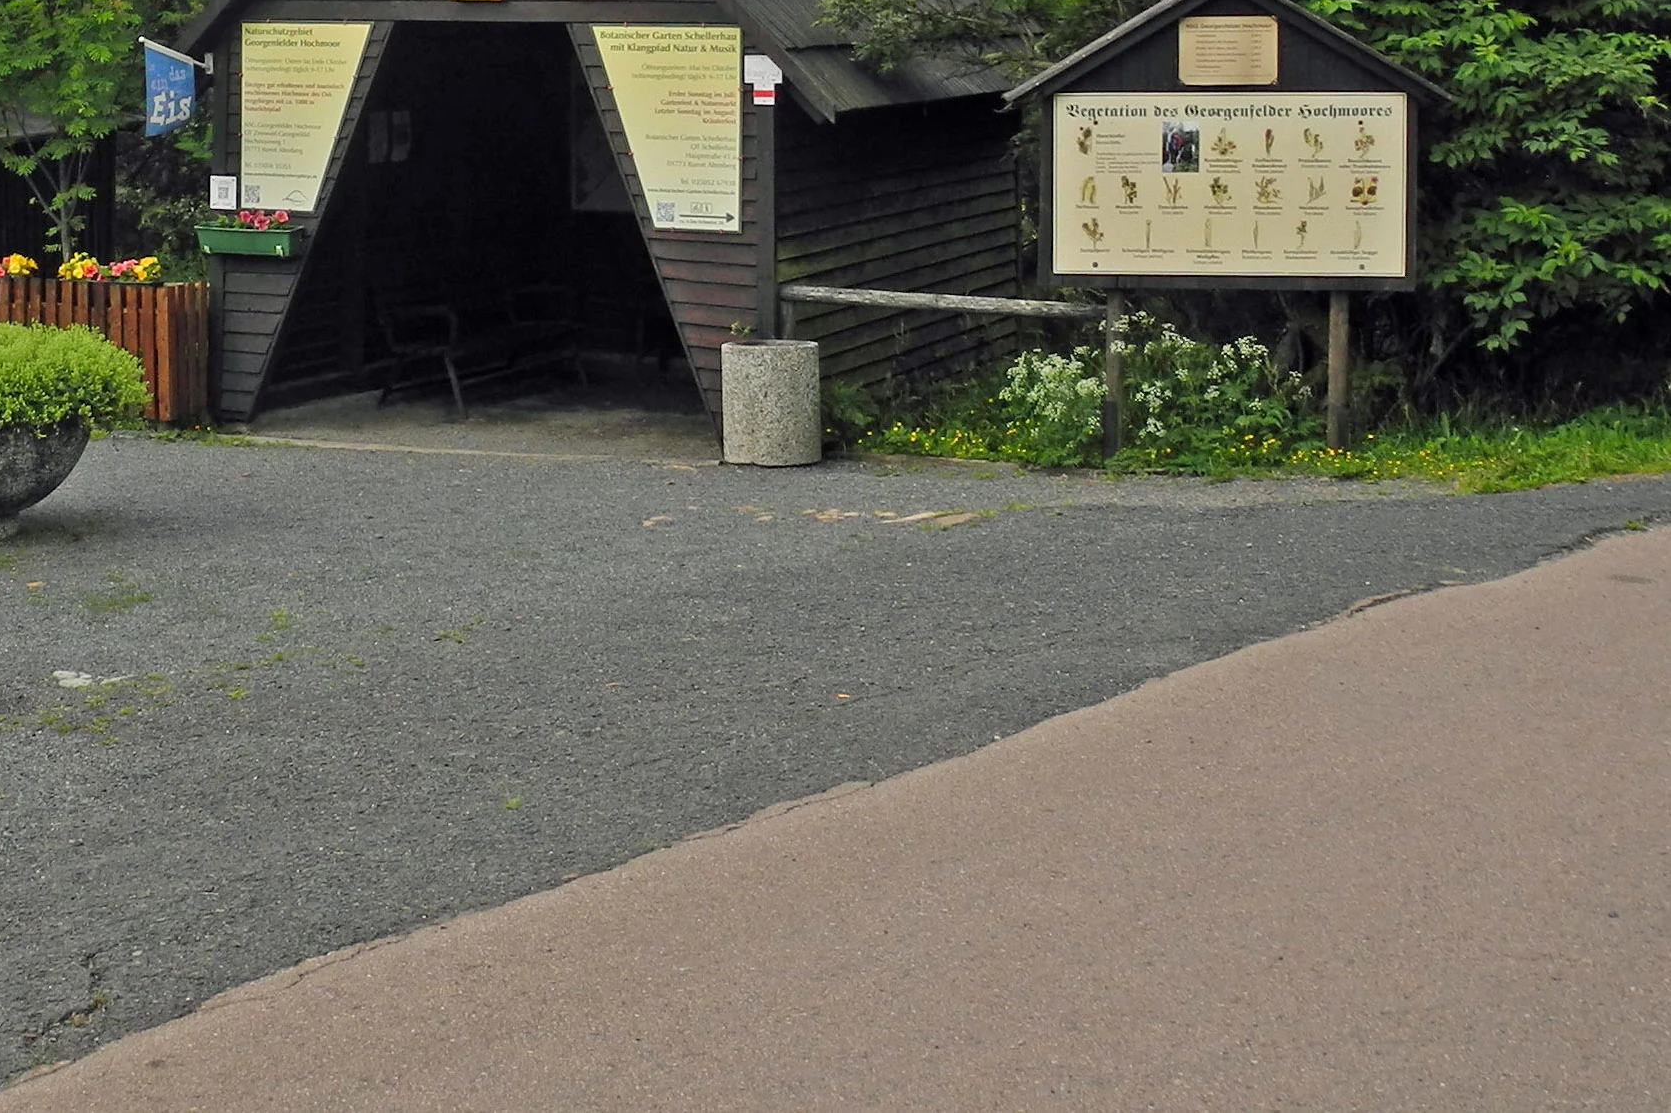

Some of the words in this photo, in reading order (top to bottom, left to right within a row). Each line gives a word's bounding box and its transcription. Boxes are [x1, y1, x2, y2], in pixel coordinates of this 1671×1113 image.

[245, 28, 313, 36] Naturschutzgebiet
[600, 31, 650, 40] Botanischer
[652, 31, 682, 40] Garten
[685, 31, 736, 40] Schellerhau
[245, 38, 298, 48] Georgenfelder
[300, 39, 340, 47] Hochmoor
[628, 44, 670, 54] Klangpfad
[673, 44, 697, 52] Natur
[710, 44, 736, 52] Musik
[170, 66, 186, 81] das
[150, 90, 192, 126] Eis
[1066, 104, 1147, 121] Vegetation
[1154, 106, 1178, 117] des
[1185, 104, 1292, 121] Georgenfelder
[1298, 104, 1392, 119] Hochmoores
